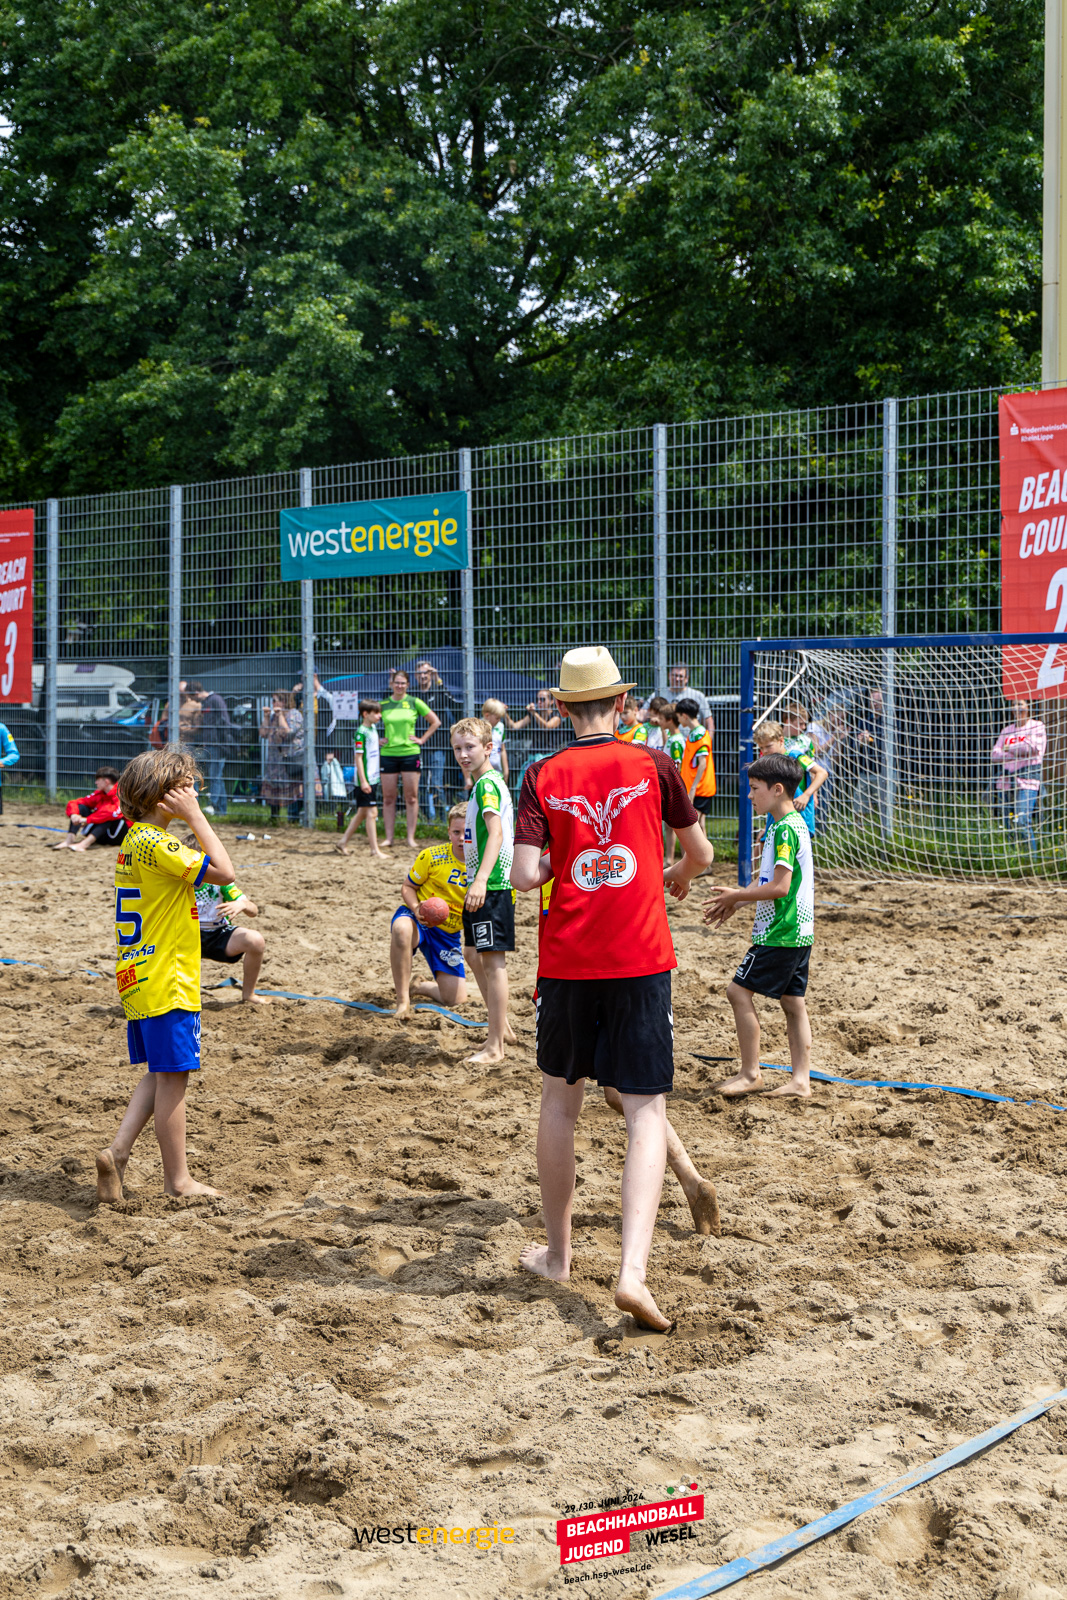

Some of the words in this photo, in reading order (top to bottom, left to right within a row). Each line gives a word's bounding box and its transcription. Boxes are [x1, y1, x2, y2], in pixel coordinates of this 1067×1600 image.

[288, 508, 458, 557] westenergie
[0, 556, 27, 586] EACH
[0, 586, 27, 615] OURT
[1037, 567, 1067, 690] 2
[1, 621, 18, 696] 3
[581, 854, 627, 878] HSG
[586, 870, 623, 886] WESEL
[114, 887, 143, 947] 5
